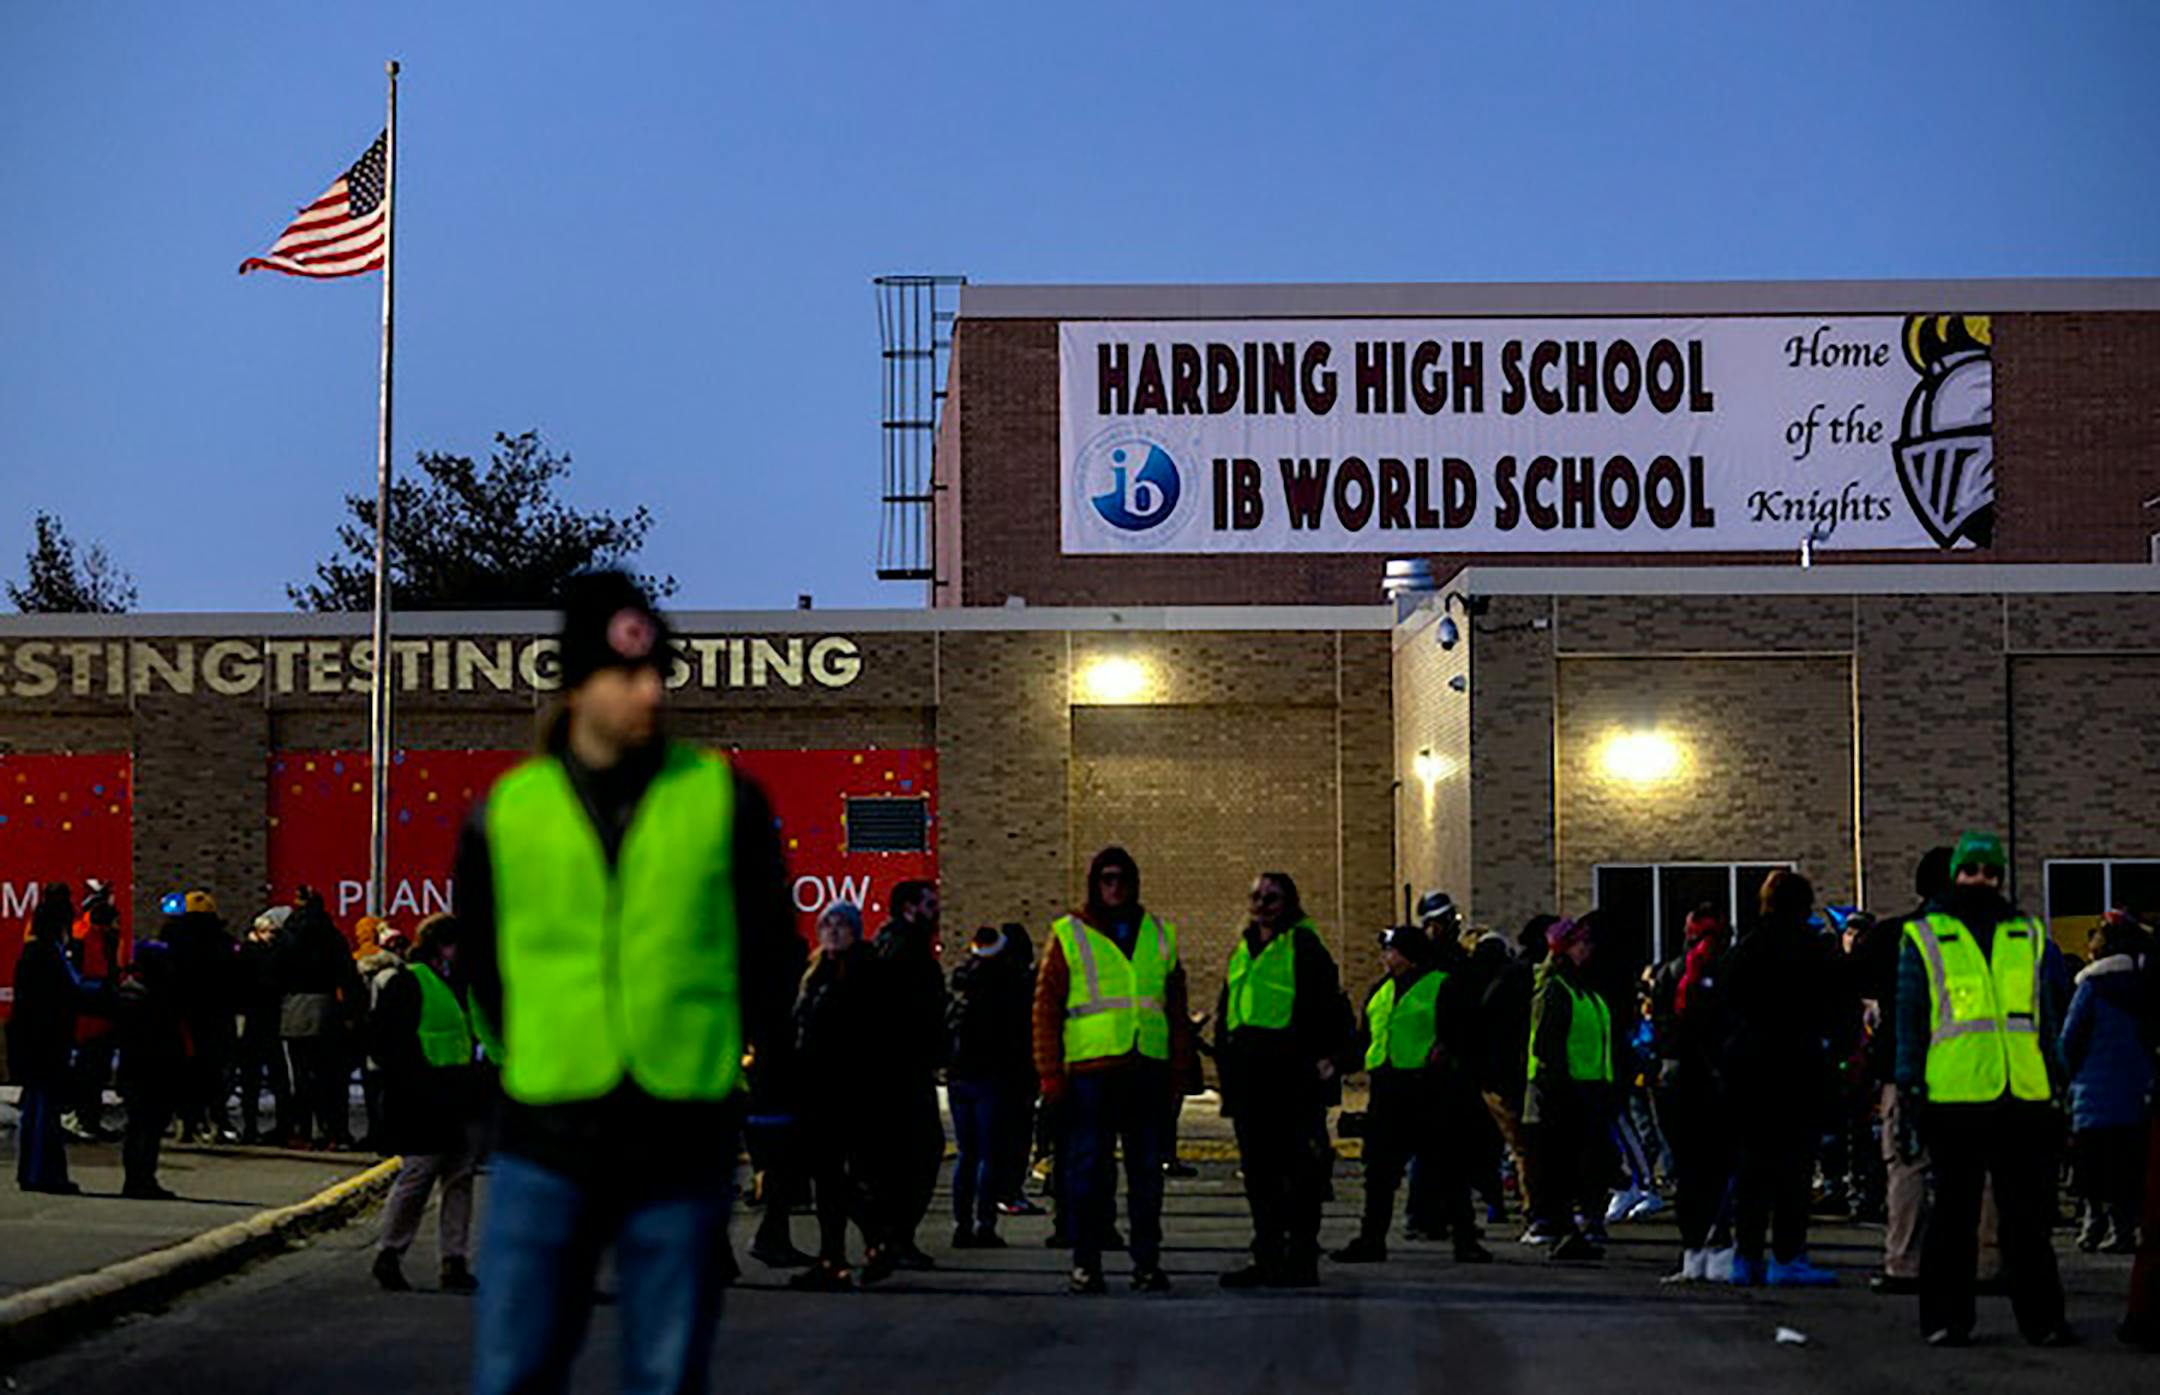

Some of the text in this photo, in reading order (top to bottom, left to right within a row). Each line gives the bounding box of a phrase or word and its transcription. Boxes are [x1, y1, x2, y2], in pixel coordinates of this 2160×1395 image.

[1784, 325, 1891, 368] Home
[1097, 338, 1715, 416] HARDING HIGH SCHOOL
[1785, 403, 1884, 462] of the
[1212, 457, 1265, 532] IB
[1278, 455, 1478, 533] WORLD
[1494, 454, 1716, 532] SCHOOL
[1747, 480, 1893, 537] Knights
